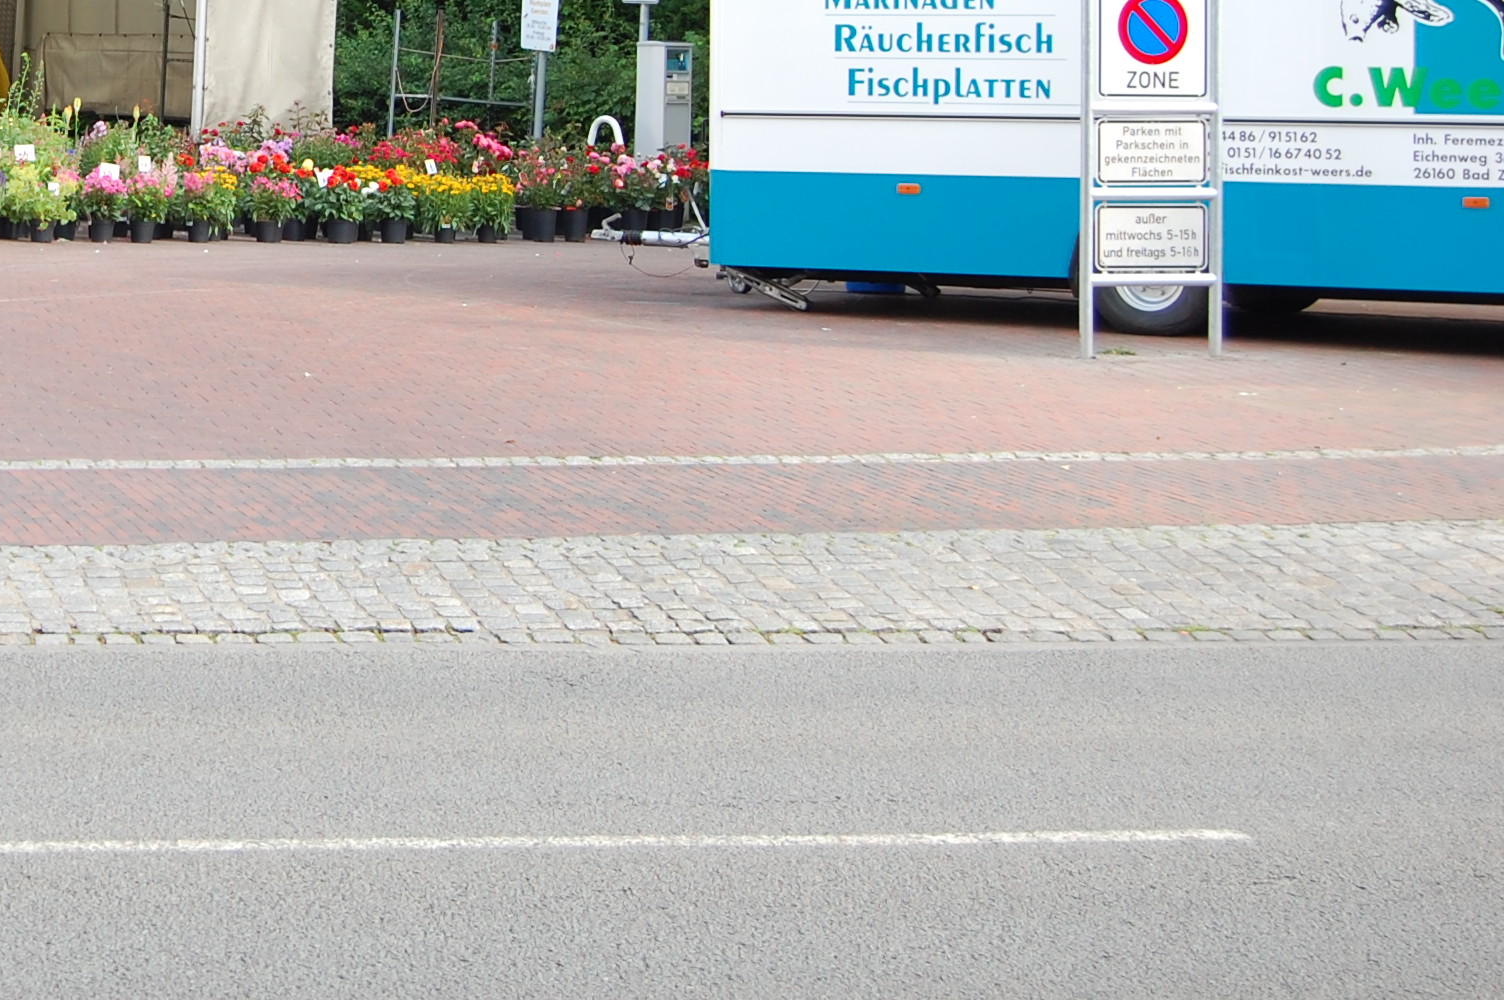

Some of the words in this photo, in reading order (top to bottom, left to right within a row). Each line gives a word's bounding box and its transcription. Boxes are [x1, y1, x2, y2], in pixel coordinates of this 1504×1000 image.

[834, 22, 1053, 54] Räucherfisch
[848, 67, 1051, 105] Fischplatten
[1126, 71, 1179, 89] ZONE
[1122, 126, 1160, 136] Parken
[1164, 126, 1182, 136] mit
[1116, 140, 1175, 150] Parkschein
[1179, 140, 1189, 150] in
[1413, 133, 1437, 145] Inh.
[1104, 153, 1201, 166] gekennzeichneten
[1413, 150, 1487, 167] Eichenweg
[1131, 167, 1174, 178] Flächen
[1221, 162, 1373, 178] ischfeinkost-weers.de
[1413, 167, 1456, 180] 26160
[1462, 168, 1490, 180] Bad
[1135, 213, 1167, 224] außer
[1105, 229, 1162, 241] mittwochs
[1103, 247, 1123, 258] und
[1126, 246, 1166, 260] freitags
